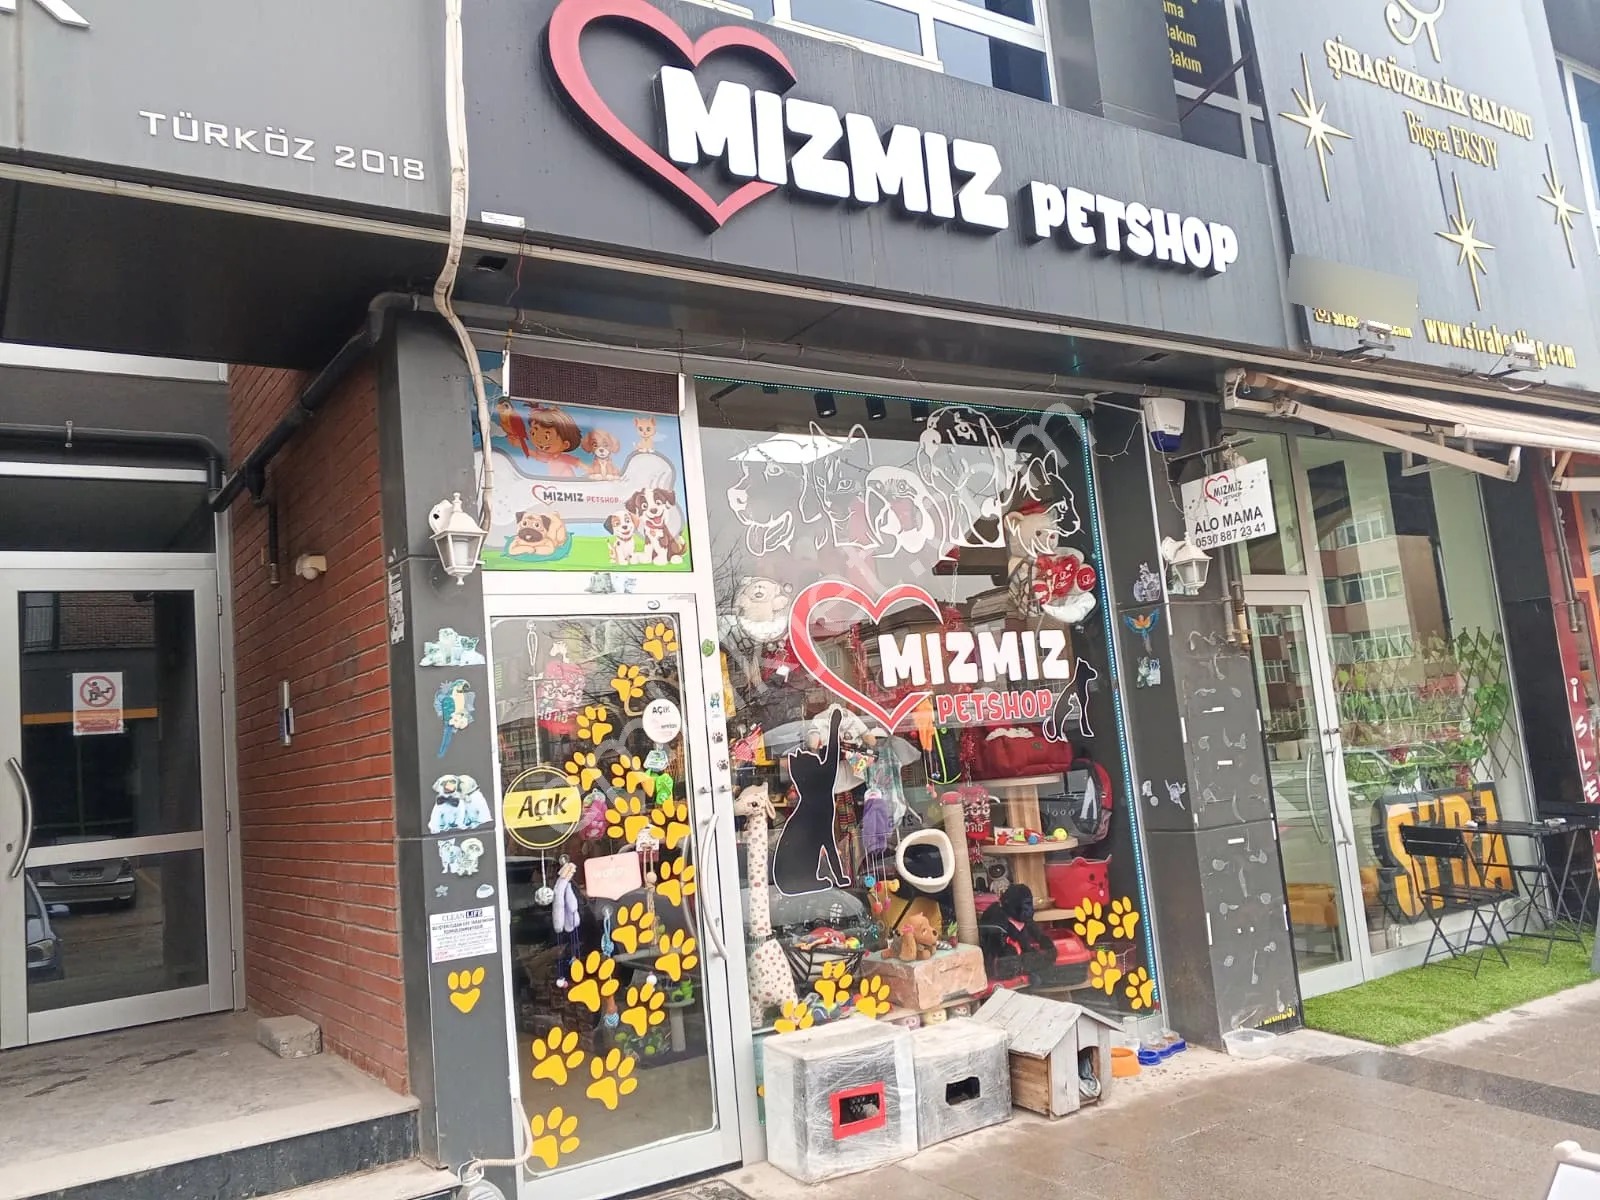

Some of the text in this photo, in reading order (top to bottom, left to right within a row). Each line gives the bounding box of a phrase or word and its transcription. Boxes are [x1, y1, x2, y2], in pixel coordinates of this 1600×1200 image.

[1165, 22, 1197, 48] akım
[1468, 93, 1535, 141] SALONU
[139, 110, 425, 181] TÜRKÖZ 2018
[1403, 110, 1499, 170] Büşra ERSOY
[658, 65, 1239, 273] MIZMIZ PETSHOP
[1422, 318, 1577, 370] www.sirahelig.com
[543, 491, 620, 504] MIZMIZ PETSHOP
[1213, 480, 1243, 498] MIZMIZ
[1194, 505, 1264, 535] ALO MAMA
[1195, 522, 1267, 548] 0530 887 23 41
[877, 629, 1070, 688] MIZMIZ
[935, 688, 1055, 725] PETSHOP
[517, 793, 568, 822] Açık
